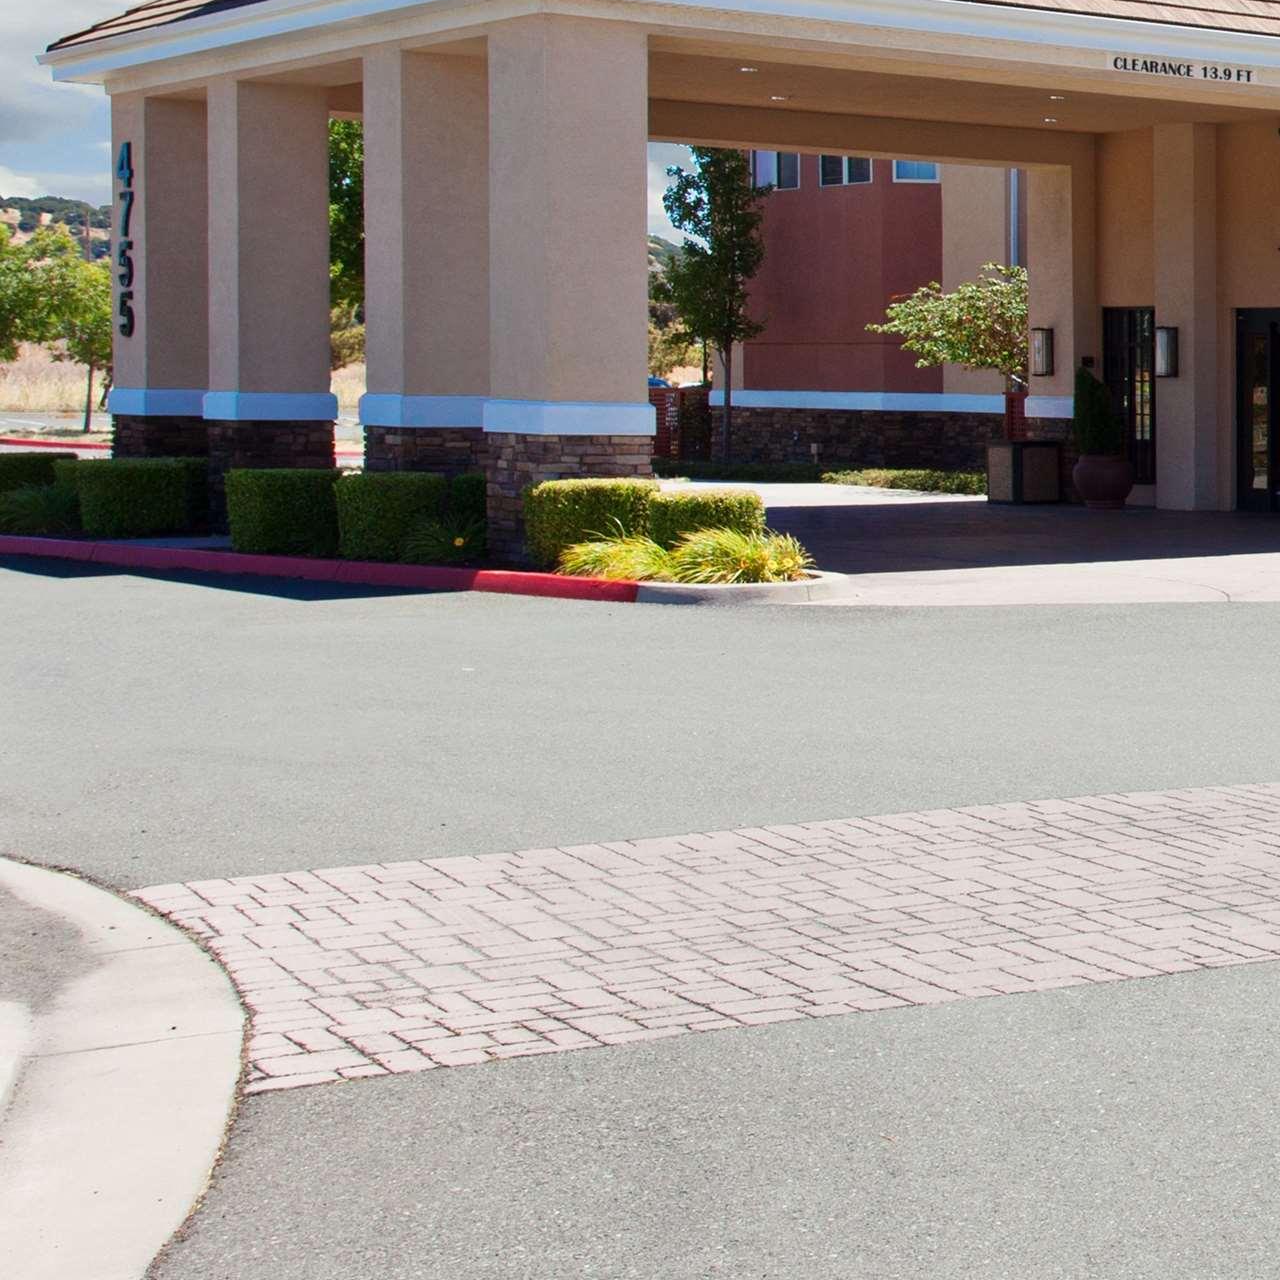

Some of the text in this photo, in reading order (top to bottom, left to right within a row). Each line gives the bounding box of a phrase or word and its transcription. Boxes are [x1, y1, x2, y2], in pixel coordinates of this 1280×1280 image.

[1113, 56, 1253, 82] CLEARANCE 13.9 FT
[116, 141, 135, 338] 4755
